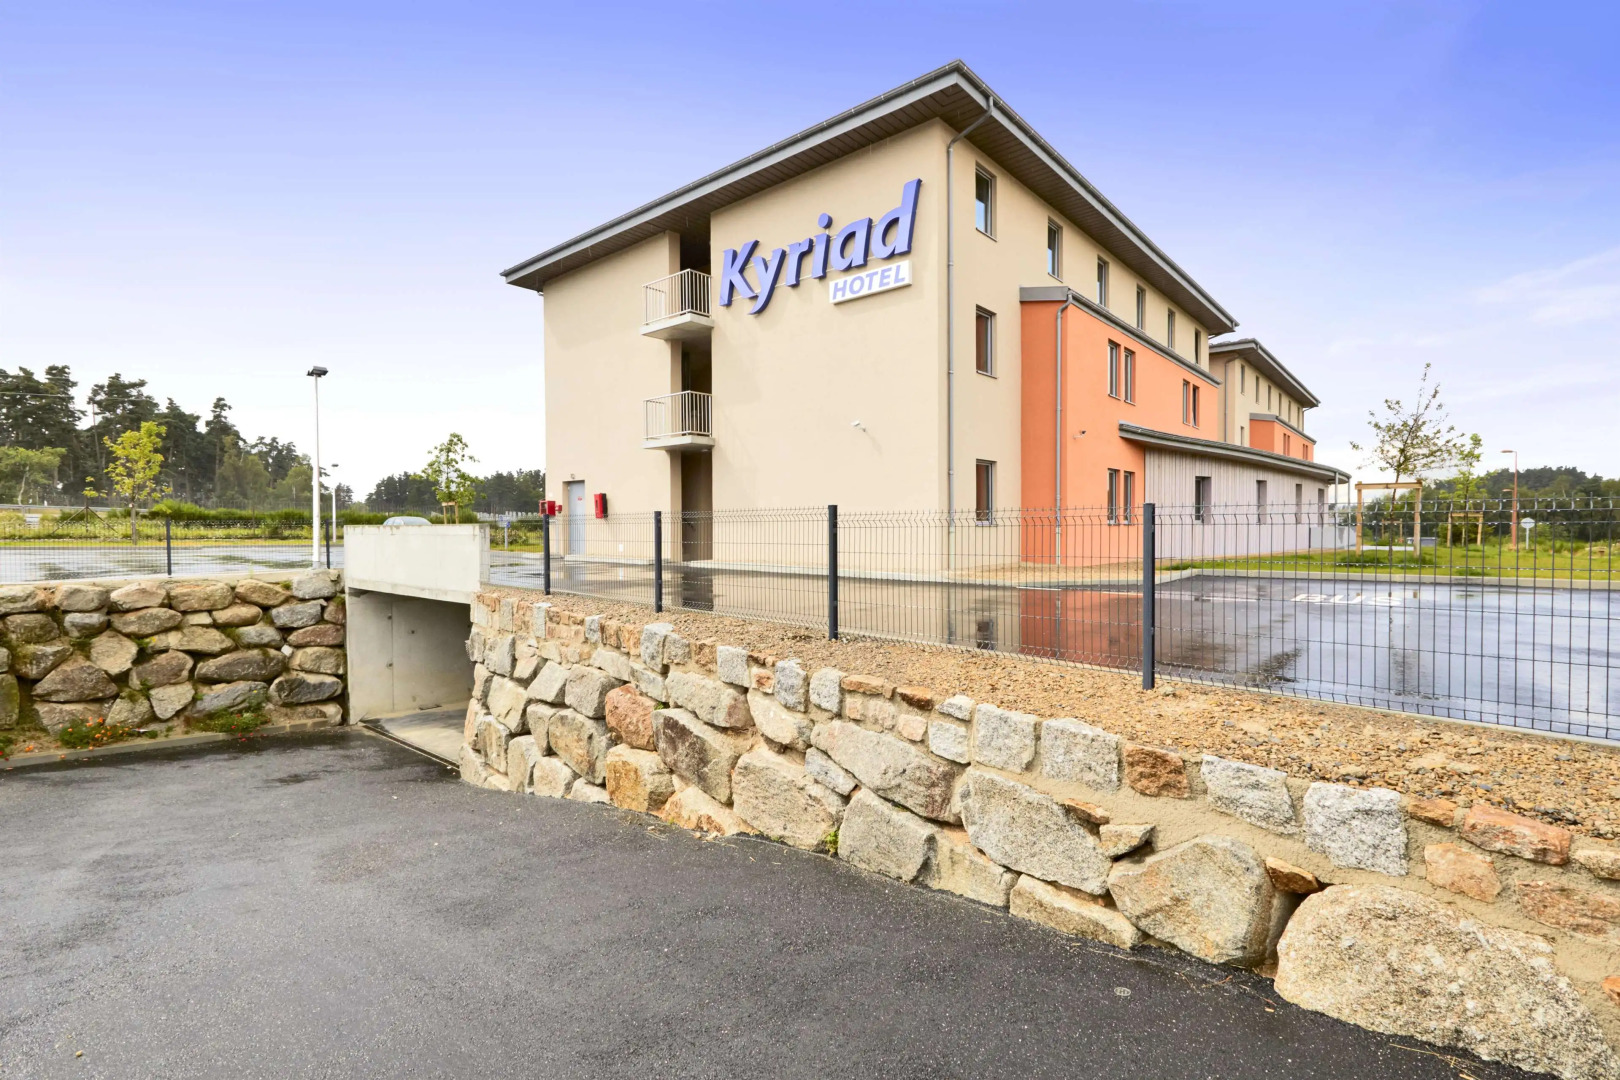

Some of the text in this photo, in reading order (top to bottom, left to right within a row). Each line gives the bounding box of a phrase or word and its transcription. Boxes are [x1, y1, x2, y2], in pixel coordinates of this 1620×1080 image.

[719, 178, 922, 315] Kyriad
[832, 264, 906, 300] HOTEL
[1290, 593, 1402, 606] BUS
